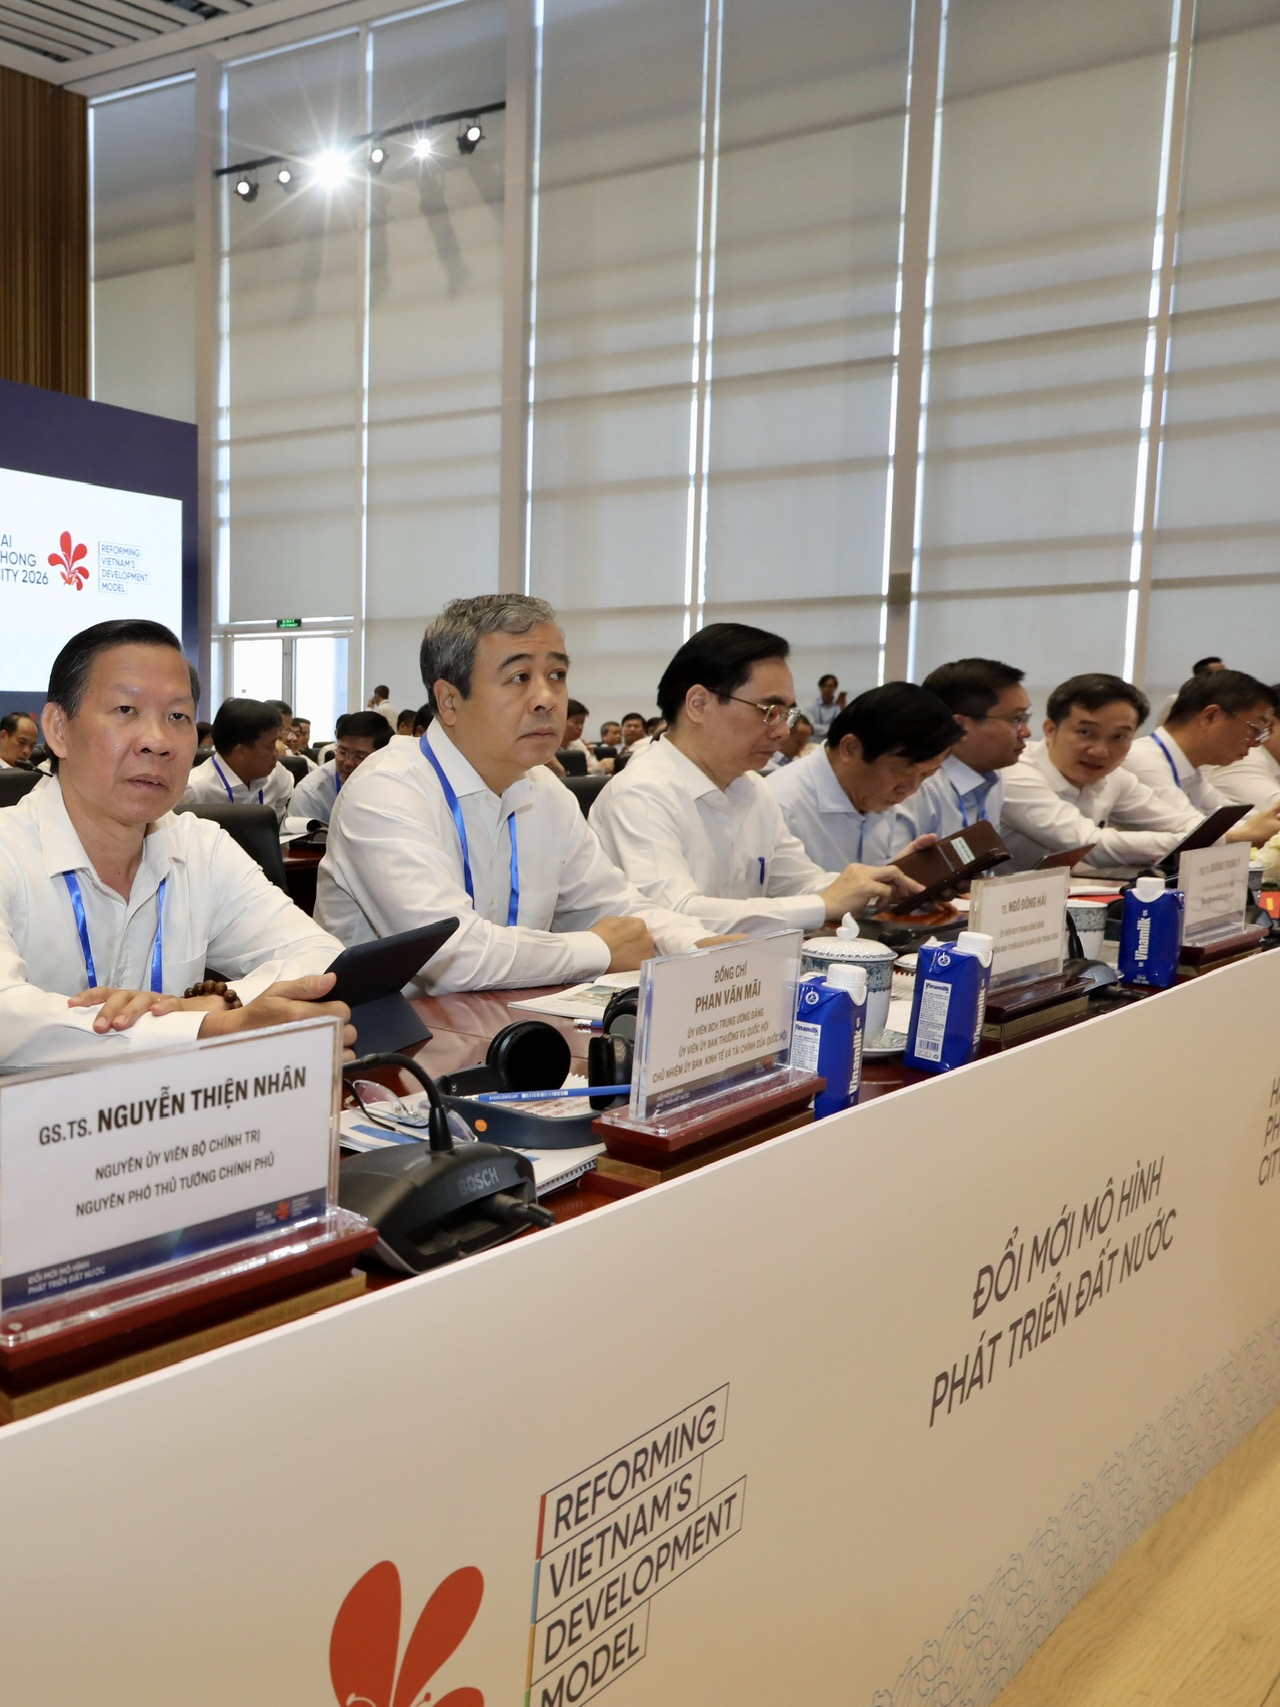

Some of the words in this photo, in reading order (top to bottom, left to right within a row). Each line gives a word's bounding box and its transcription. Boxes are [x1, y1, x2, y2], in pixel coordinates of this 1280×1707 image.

[101, 544, 140, 558] REFORMING
[101, 558, 136, 568] VIETNAM'S
[22, 569, 48, 585] 2026
[101, 569, 148, 582] DEVELOPMENT
[101, 583, 126, 592] MODEL
[1134, 917, 1151, 960] Vinamilk
[714, 964, 734, 984] ĐỒNG
[736, 960, 748, 978] CHÍ
[694, 994, 721, 1014] PHAN
[724, 986, 742, 1004] VĂN
[744, 979, 762, 1000] MÃI
[720, 1016, 736, 1030] TRUNG
[848, 1028, 862, 1096] Vinamilk
[39, 1118, 92, 1146] GS.TS.
[98, 1085, 185, 1134] NGUYỄN
[191, 1078, 248, 1112] THIỆN
[254, 1065, 306, 1098] NHÂN
[96, 1156, 142, 1181] NGUYÊN
[146, 1151, 161, 1168] ỦY
[164, 1146, 188, 1164] VIÊN
[192, 1140, 206, 1158] BỘ
[209, 1134, 242, 1153] CHÍNH
[245, 1129, 261, 1144] TRỊ
[76, 1193, 125, 1218] NGUYÊN
[128, 1183, 152, 1204] PHÓ
[154, 1176, 176, 1196] THỦ
[180, 1170, 216, 1191] TƯỚNG
[219, 1160, 252, 1180] CHÍNH
[254, 1151, 275, 1171] PHỦ
[457, 1167, 499, 1196] BOSCH
[972, 1226, 1024, 1320] ĐỔI
[1027, 1204, 1076, 1283] MỚI
[1078, 1176, 1115, 1250] MÔ
[1117, 1155, 1164, 1222] HÌNH
[929, 1329, 1003, 1428] PHÁT
[1008, 1270, 1072, 1368] TRIỂN
[1074, 1238, 1119, 1318] ĐẤT
[1119, 1207, 1177, 1284] NƯỚC
[554, 1404, 717, 1540] REFORMING
[550, 1473, 693, 1598] VIETNAM'S
[544, 1492, 738, 1665] DEVELOPMENT
[542, 1622, 640, 1707] MODEL
